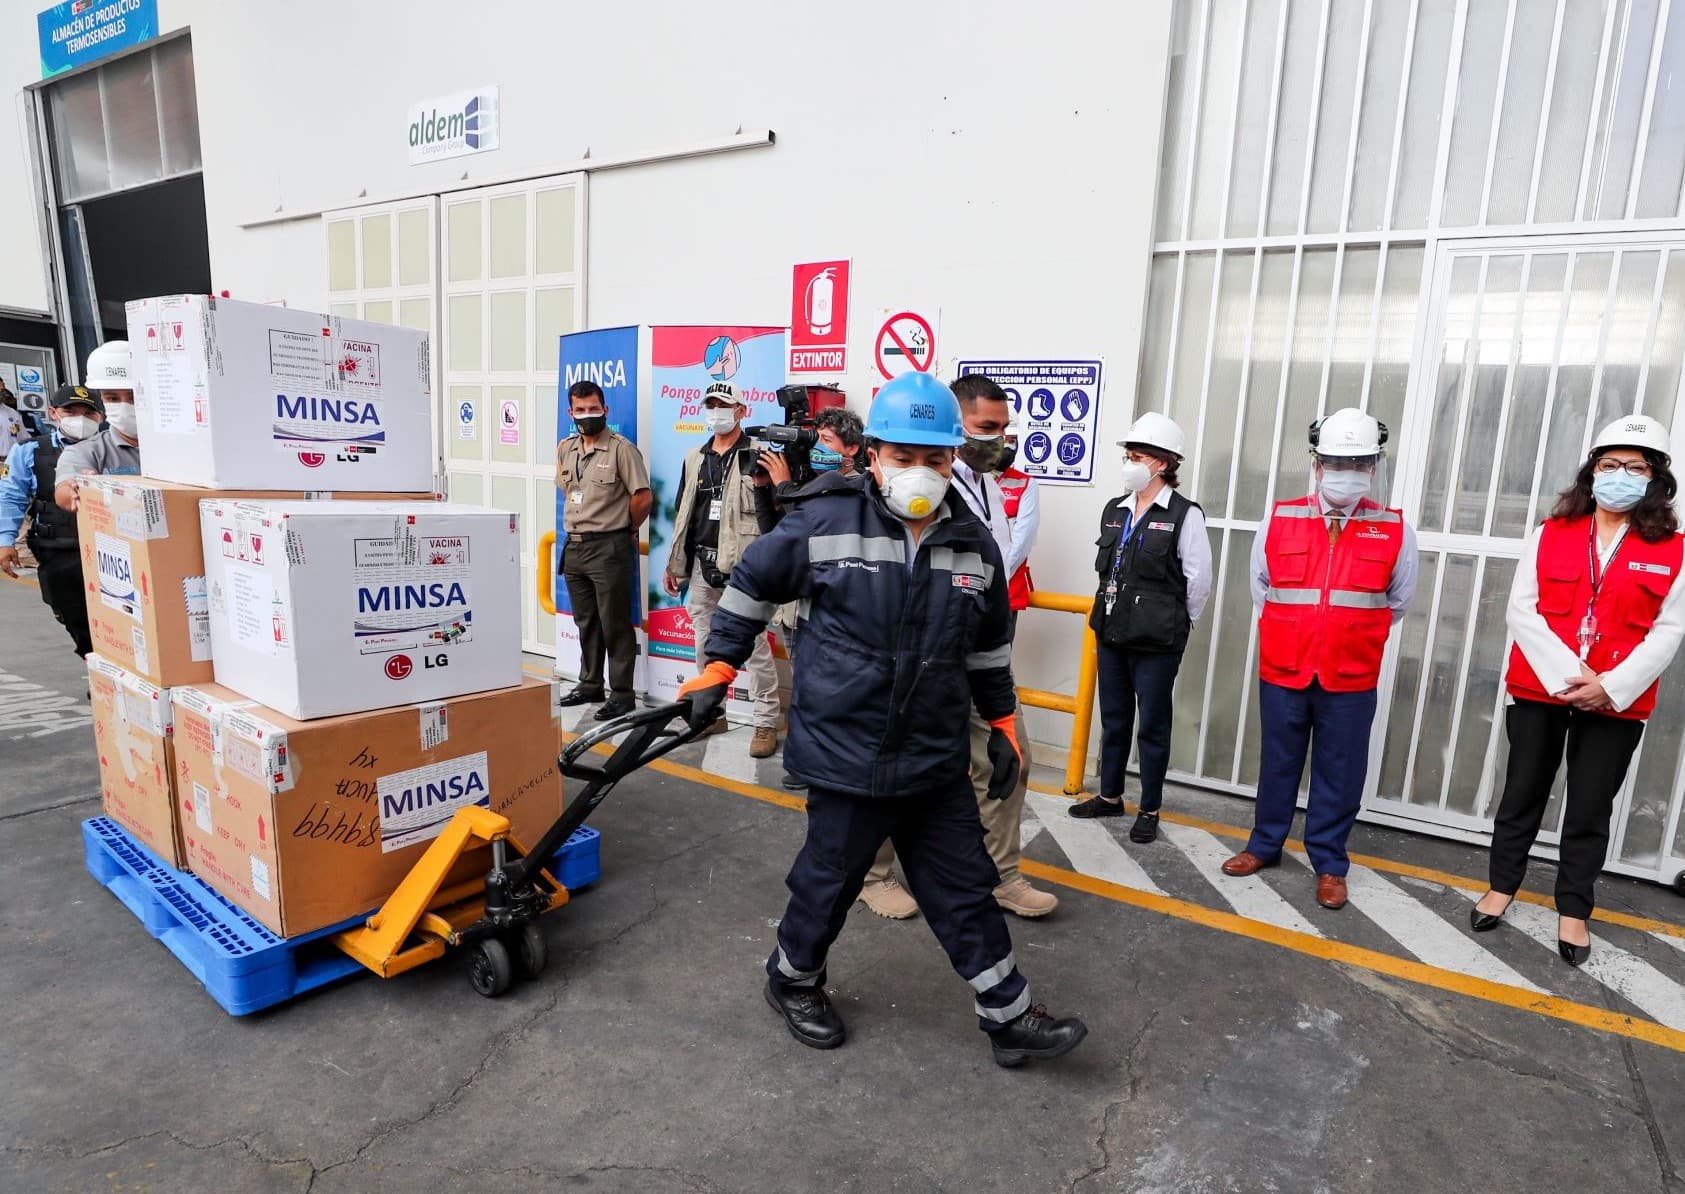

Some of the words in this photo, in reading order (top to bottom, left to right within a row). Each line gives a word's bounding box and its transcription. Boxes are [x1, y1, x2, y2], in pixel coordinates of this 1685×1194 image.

[52, 16, 84, 44] ALMACÉN
[85, 14, 95, 30] DE
[96, 0, 140, 25] PRODUCTOS
[66, 18, 126, 55] TERMOSENSIBLES
[409, 109, 464, 147] aldem
[565, 359, 626, 390] MINSA
[792, 351, 843, 368] EXTINTOR
[969, 367, 984, 375] USO
[985, 367, 1038, 375] OBLIGATORIO
[1039, 367, 1050, 375] DE
[1051, 367, 1089, 375] EQUIPOS
[660, 384, 701, 403] Pongo
[1026, 376, 1068, 384] PERSONAL
[1069, 376, 1093, 384] (EPP)
[277, 394, 380, 425] MINSA
[910, 403, 935, 420] CENARES
[430, 539, 462, 549] VACINA
[97, 550, 132, 585] MINSA
[358, 582, 467, 613] MINSA
[424, 653, 448, 669] LG
[384, 770, 484, 819] MINSA
